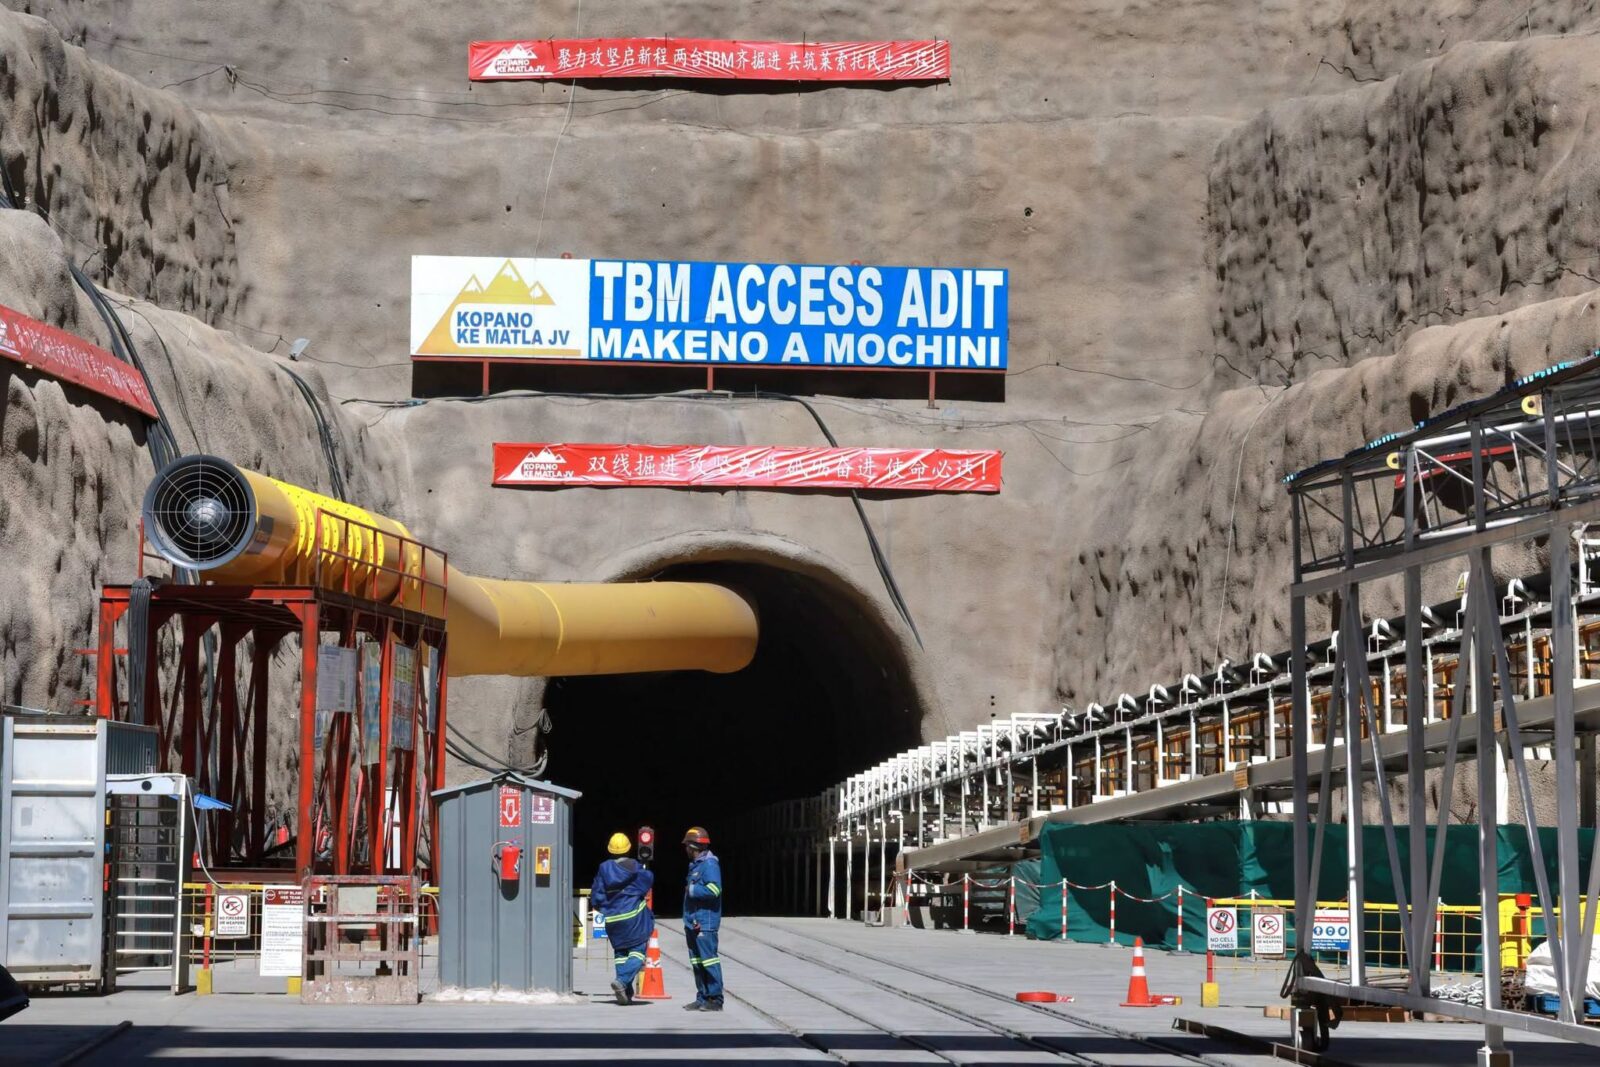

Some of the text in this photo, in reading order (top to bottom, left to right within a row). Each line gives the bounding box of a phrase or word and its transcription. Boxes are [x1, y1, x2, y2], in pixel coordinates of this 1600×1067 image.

[558, 47, 669, 68] 聚力攻坚启新程
[673, 48, 782, 70] 两台TBM齐掘进
[595, 262, 1004, 329] TBM ACCESS ADIT
[457, 312, 533, 328] KOPANO
[457, 329, 570, 345] KE MATLA JV
[591, 327, 1000, 367] MAKENO A MOCHINI
[523, 470, 575, 478] KE MATLA JV
[588, 454, 678, 477] 双线掘进
[885, 457, 988, 481] 使命必达！
